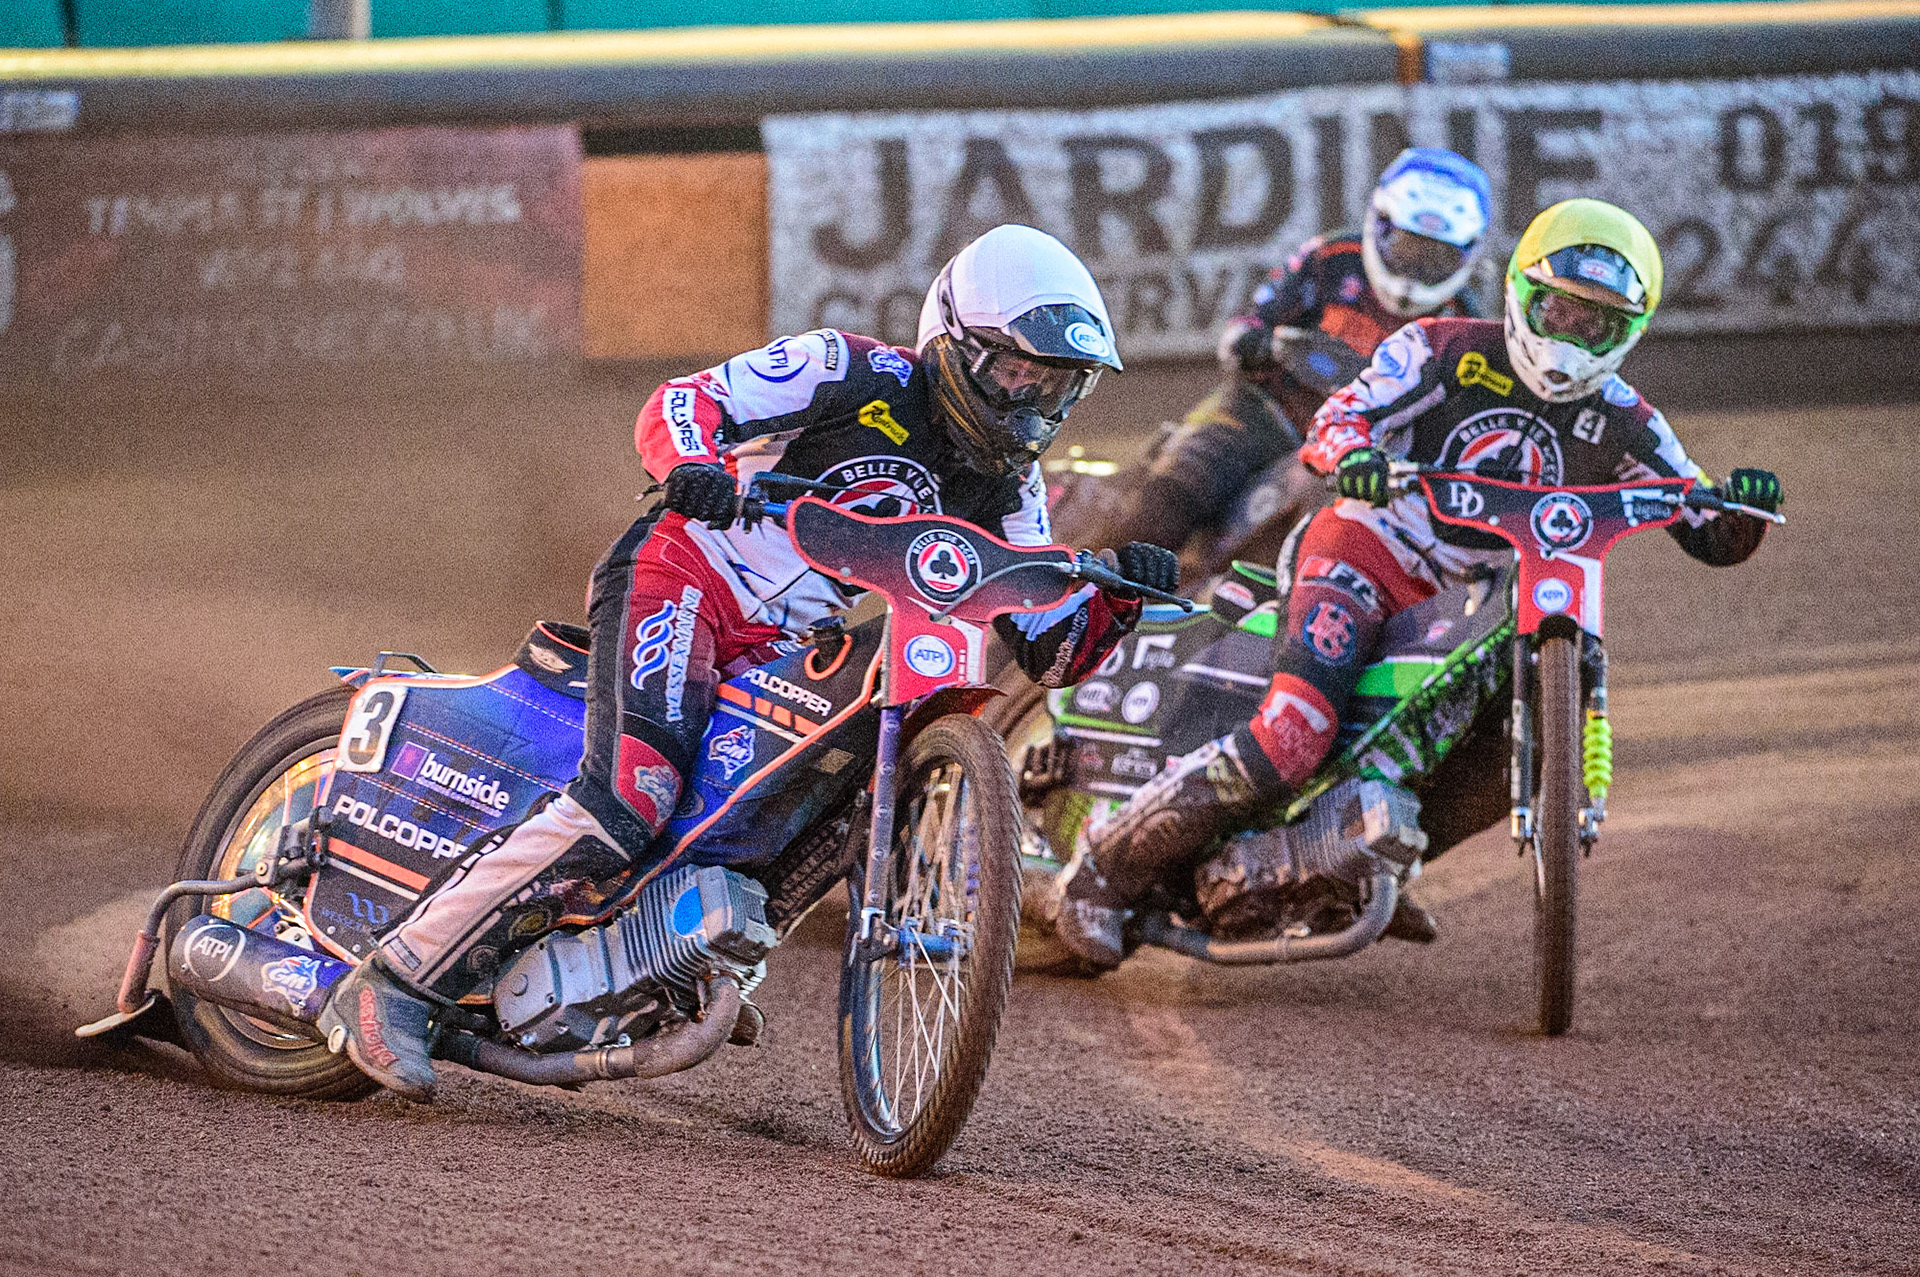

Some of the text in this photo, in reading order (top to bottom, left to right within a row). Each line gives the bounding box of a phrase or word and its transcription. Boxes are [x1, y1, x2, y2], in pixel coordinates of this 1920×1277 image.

[841, 463, 933, 500] BELLE VUE
[914, 649, 945, 663] ATPI
[741, 668, 832, 716] POLCOPPER
[348, 691, 394, 765] 3
[420, 753, 510, 809] burnside
[332, 794, 468, 859] POLCOPPE
[192, 935, 233, 962] ATPI
